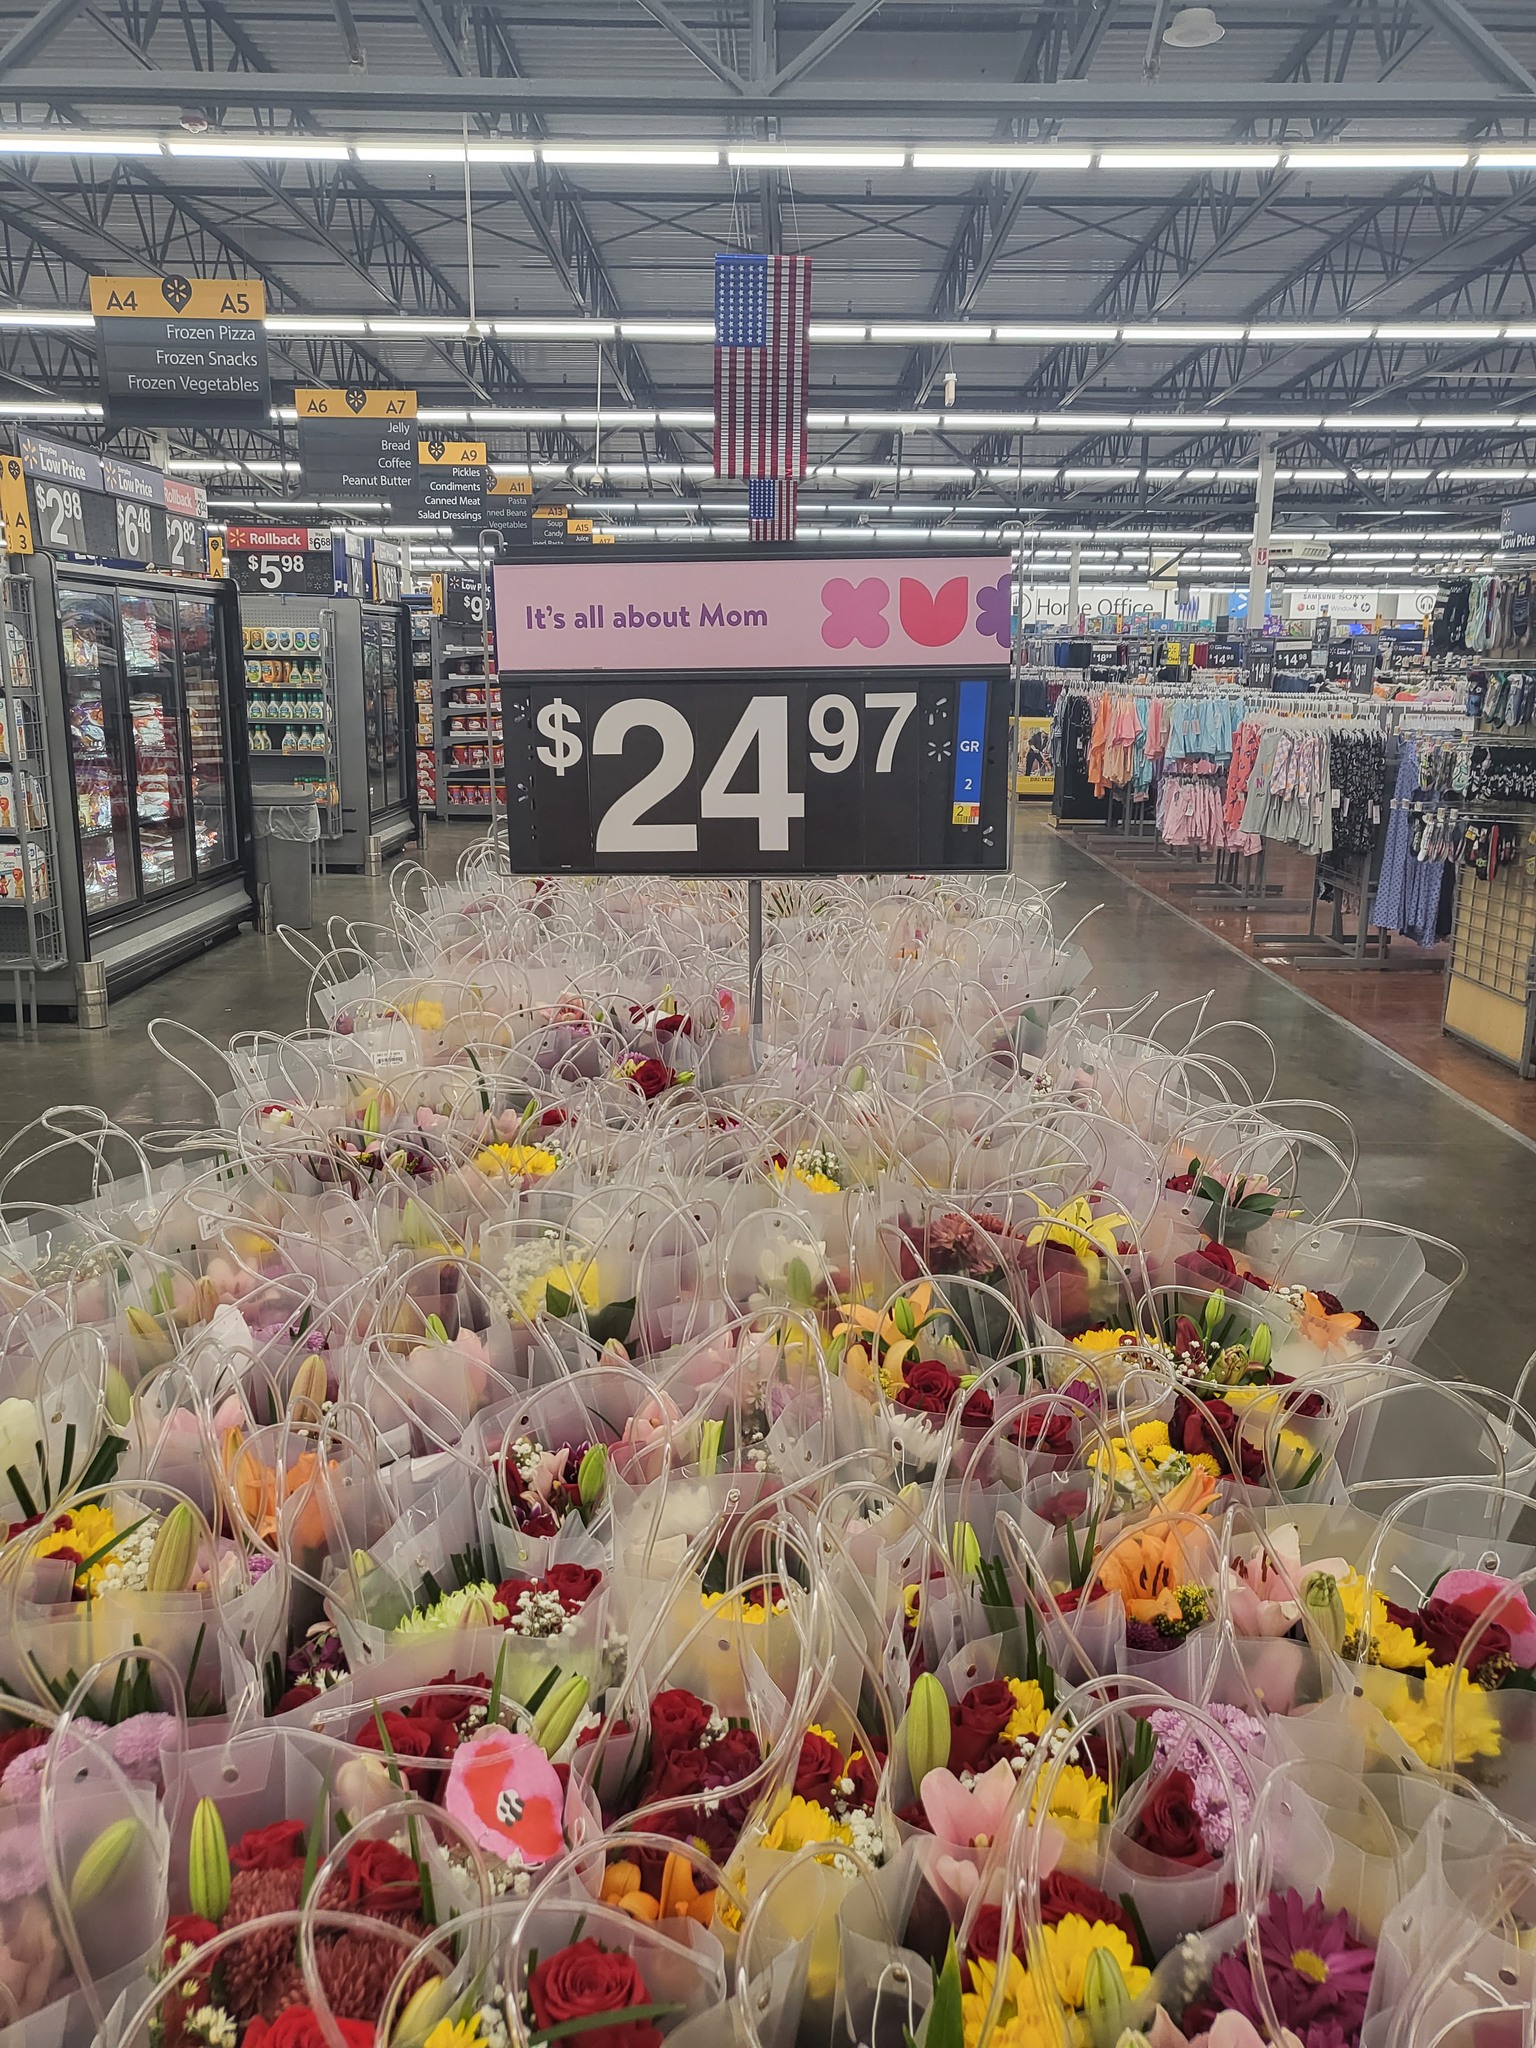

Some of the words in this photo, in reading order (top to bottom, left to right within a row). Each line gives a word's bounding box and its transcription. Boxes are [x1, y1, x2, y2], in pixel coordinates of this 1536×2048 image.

[106, 290, 138, 311] A4
[220, 293, 250, 314] A5
[166, 324, 214, 340] Frozen
[219, 325, 256, 341] Pizza
[156, 350, 204, 366] Frozen
[208, 351, 258, 367] Snacks
[128, 375, 176, 390] Frozen
[181, 376, 259, 394] Vegetables
[307, 399, 328, 413] A6
[385, 400, 406, 415] A7
[387, 422, 410, 435] Jelly
[381, 439, 411, 451] Bread
[460, 450, 478, 462] A9
[40, 452, 60, 474] Low
[61, 458, 86, 481] Price
[378, 457, 412, 469] Coffee
[452, 467, 481, 477] Pickles
[118, 473, 134, 493] Low
[135, 477, 153, 498] Price
[342, 475, 377, 487] Peanut
[380, 475, 412, 487] Butter
[430, 481, 481, 491] Condiments
[509, 482, 525, 492] A11
[424, 496, 457, 506] Canned
[459, 496, 481, 506] Meat
[508, 497, 527, 505] Pasta
[417, 510, 441, 520] Salad
[443, 510, 482, 521] Dressings
[487, 508, 505, 517] nned
[506, 508, 528, 517] Beans
[548, 508, 563, 516] A13
[16, 512, 27, 528] A
[489, 521, 528, 529] Vegetables
[547, 520, 564, 528] Soup
[543, 530, 564, 538] Candy
[575, 524, 589, 532] A15
[19, 534, 27, 550] 3
[249, 532, 301, 546] Rollback
[309, 537, 331, 550] $668
[1501, 536, 1516, 550] Low
[1516, 532, 1536, 547] Price
[248, 554, 304, 589] $598
[461, 581, 477, 591] Low
[1098, 598, 1154, 616] Office
[574, 604, 604, 629] all
[613, 603, 690, 628] about
[700, 602, 768, 627] Mom
[960, 740, 980, 753] GR
[964, 778, 973, 790] 2
[956, 805, 964, 817] 2
